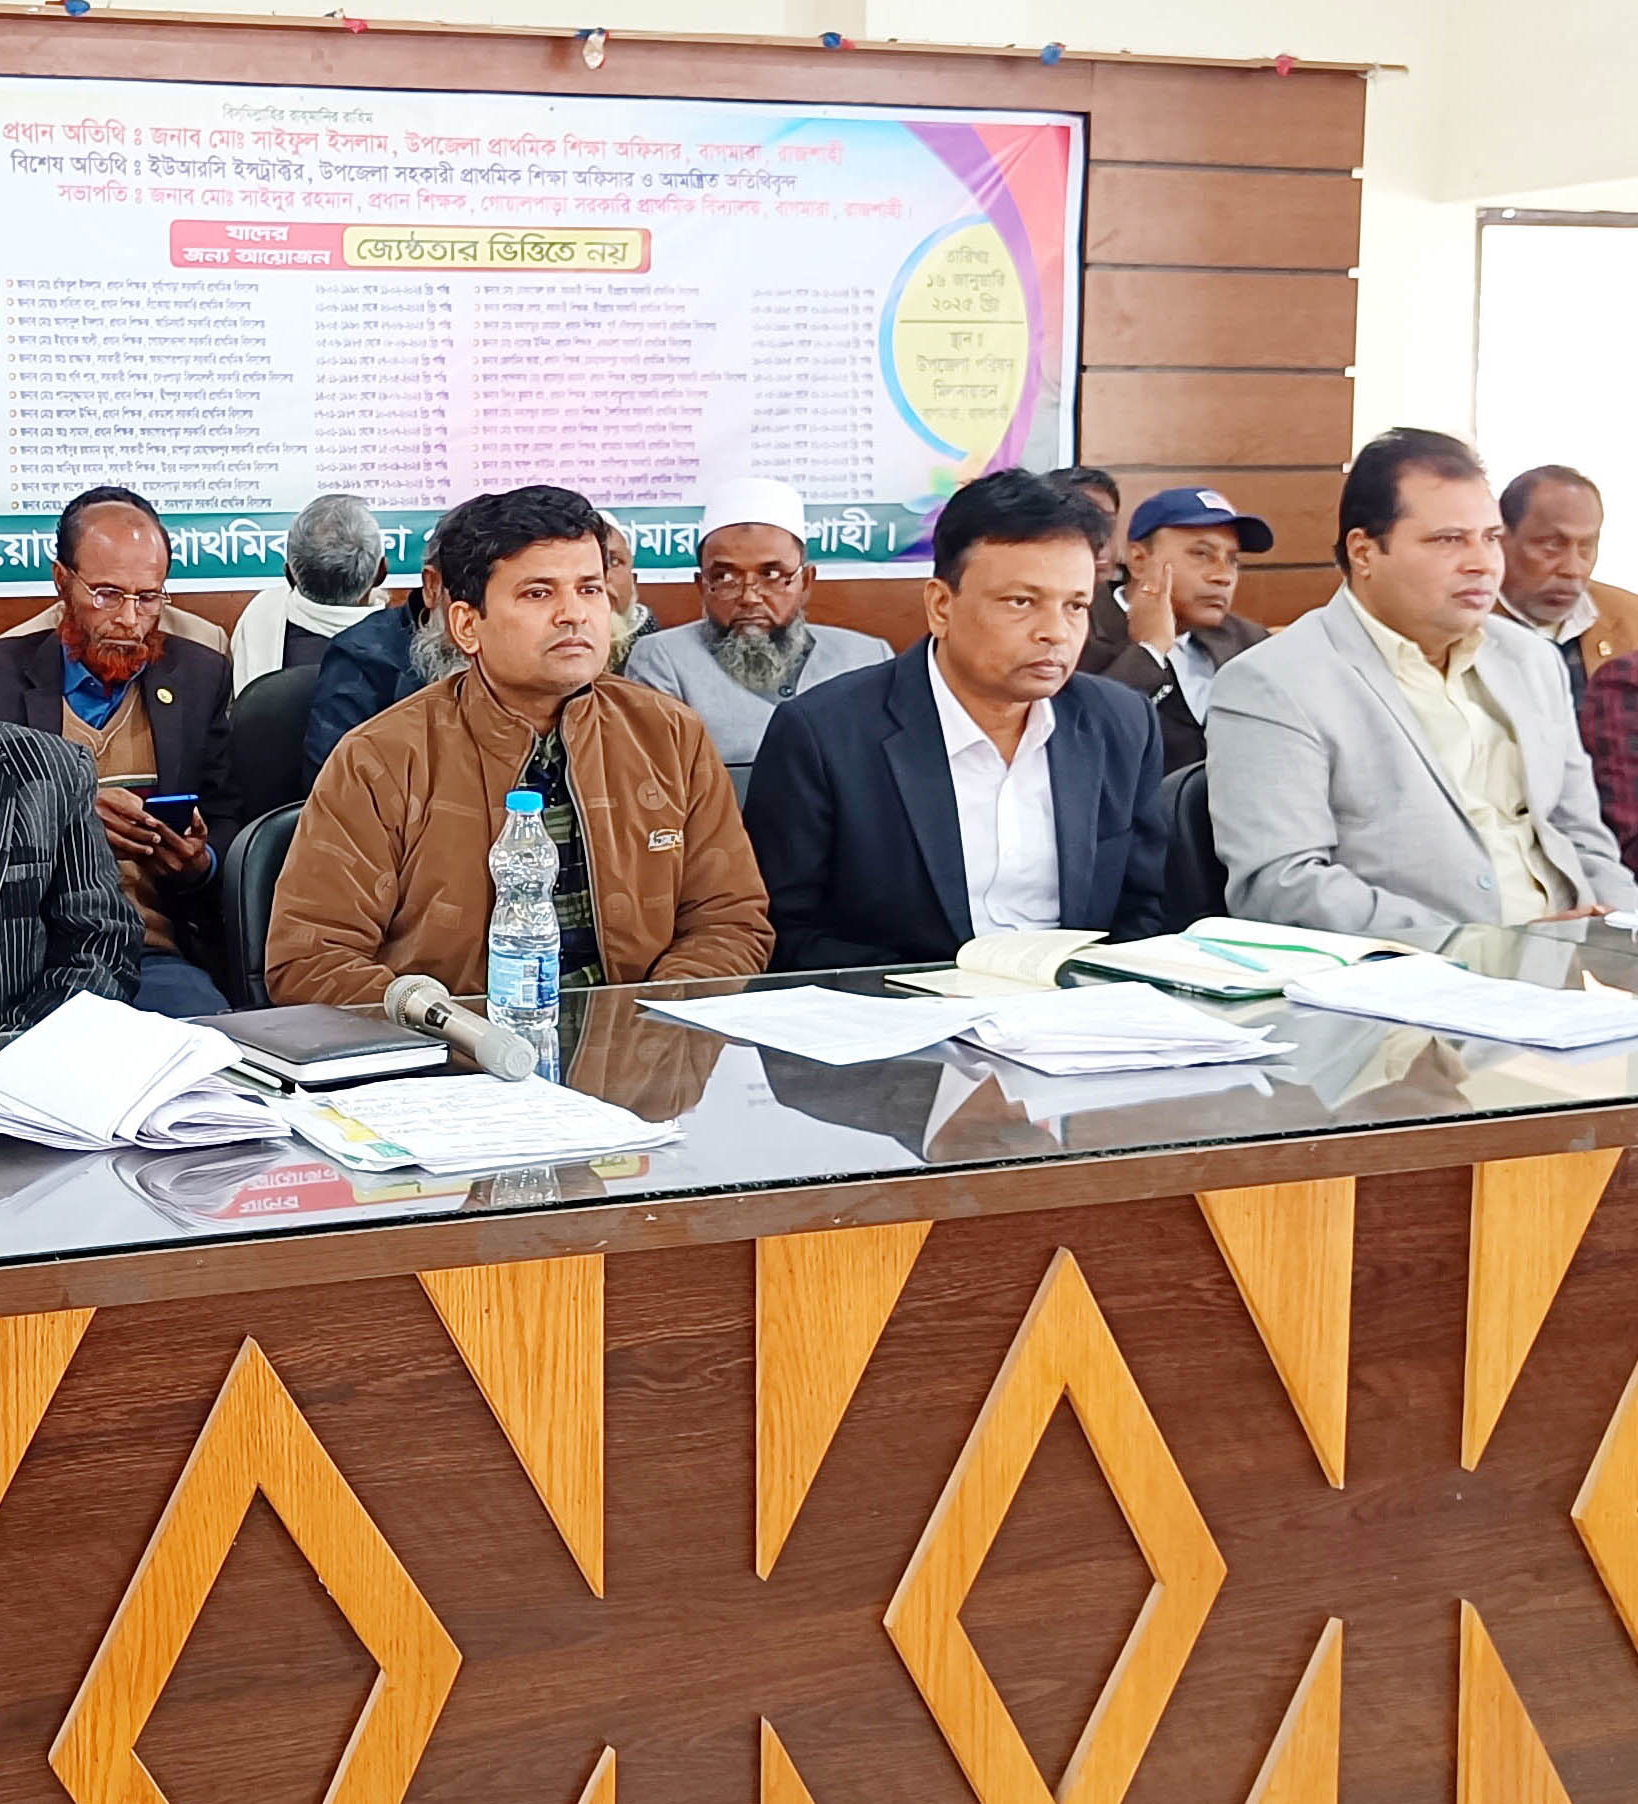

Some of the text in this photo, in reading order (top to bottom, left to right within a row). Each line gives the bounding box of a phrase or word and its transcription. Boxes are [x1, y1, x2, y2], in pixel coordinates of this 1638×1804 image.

[3, 122, 54, 144] প্রধান
[62, 118, 126, 144] অতিথি
[149, 127, 202, 148] জনাব
[251, 126, 320, 156] সাইফুল
[405, 130, 481, 157] উপজেলা
[488, 132, 557, 158] প্রাথমিক
[563, 133, 607, 160] শিক্ষা
[70, 151, 127, 176] অতিথি
[147, 153, 226, 178] ইউআরসি
[319, 159, 388, 184] উপজেলা
[395, 161, 454, 184] সহকারী
[461, 163, 522, 185] প্রাথমিক
[528, 164, 567, 187] শিক্ষা
[572, 165, 635, 188] অফিসার
[642, 174, 652, 187] ও
[57, 179, 128, 204] সভাপতি
[148, 187, 194, 205] জনাব
[368, 193, 411, 211] প্রধান
[182, 247, 331, 266] জন্য আয়োজন
[488, 232, 577, 264] ভিত্তিতে
[585, 241, 628, 265] নয়
